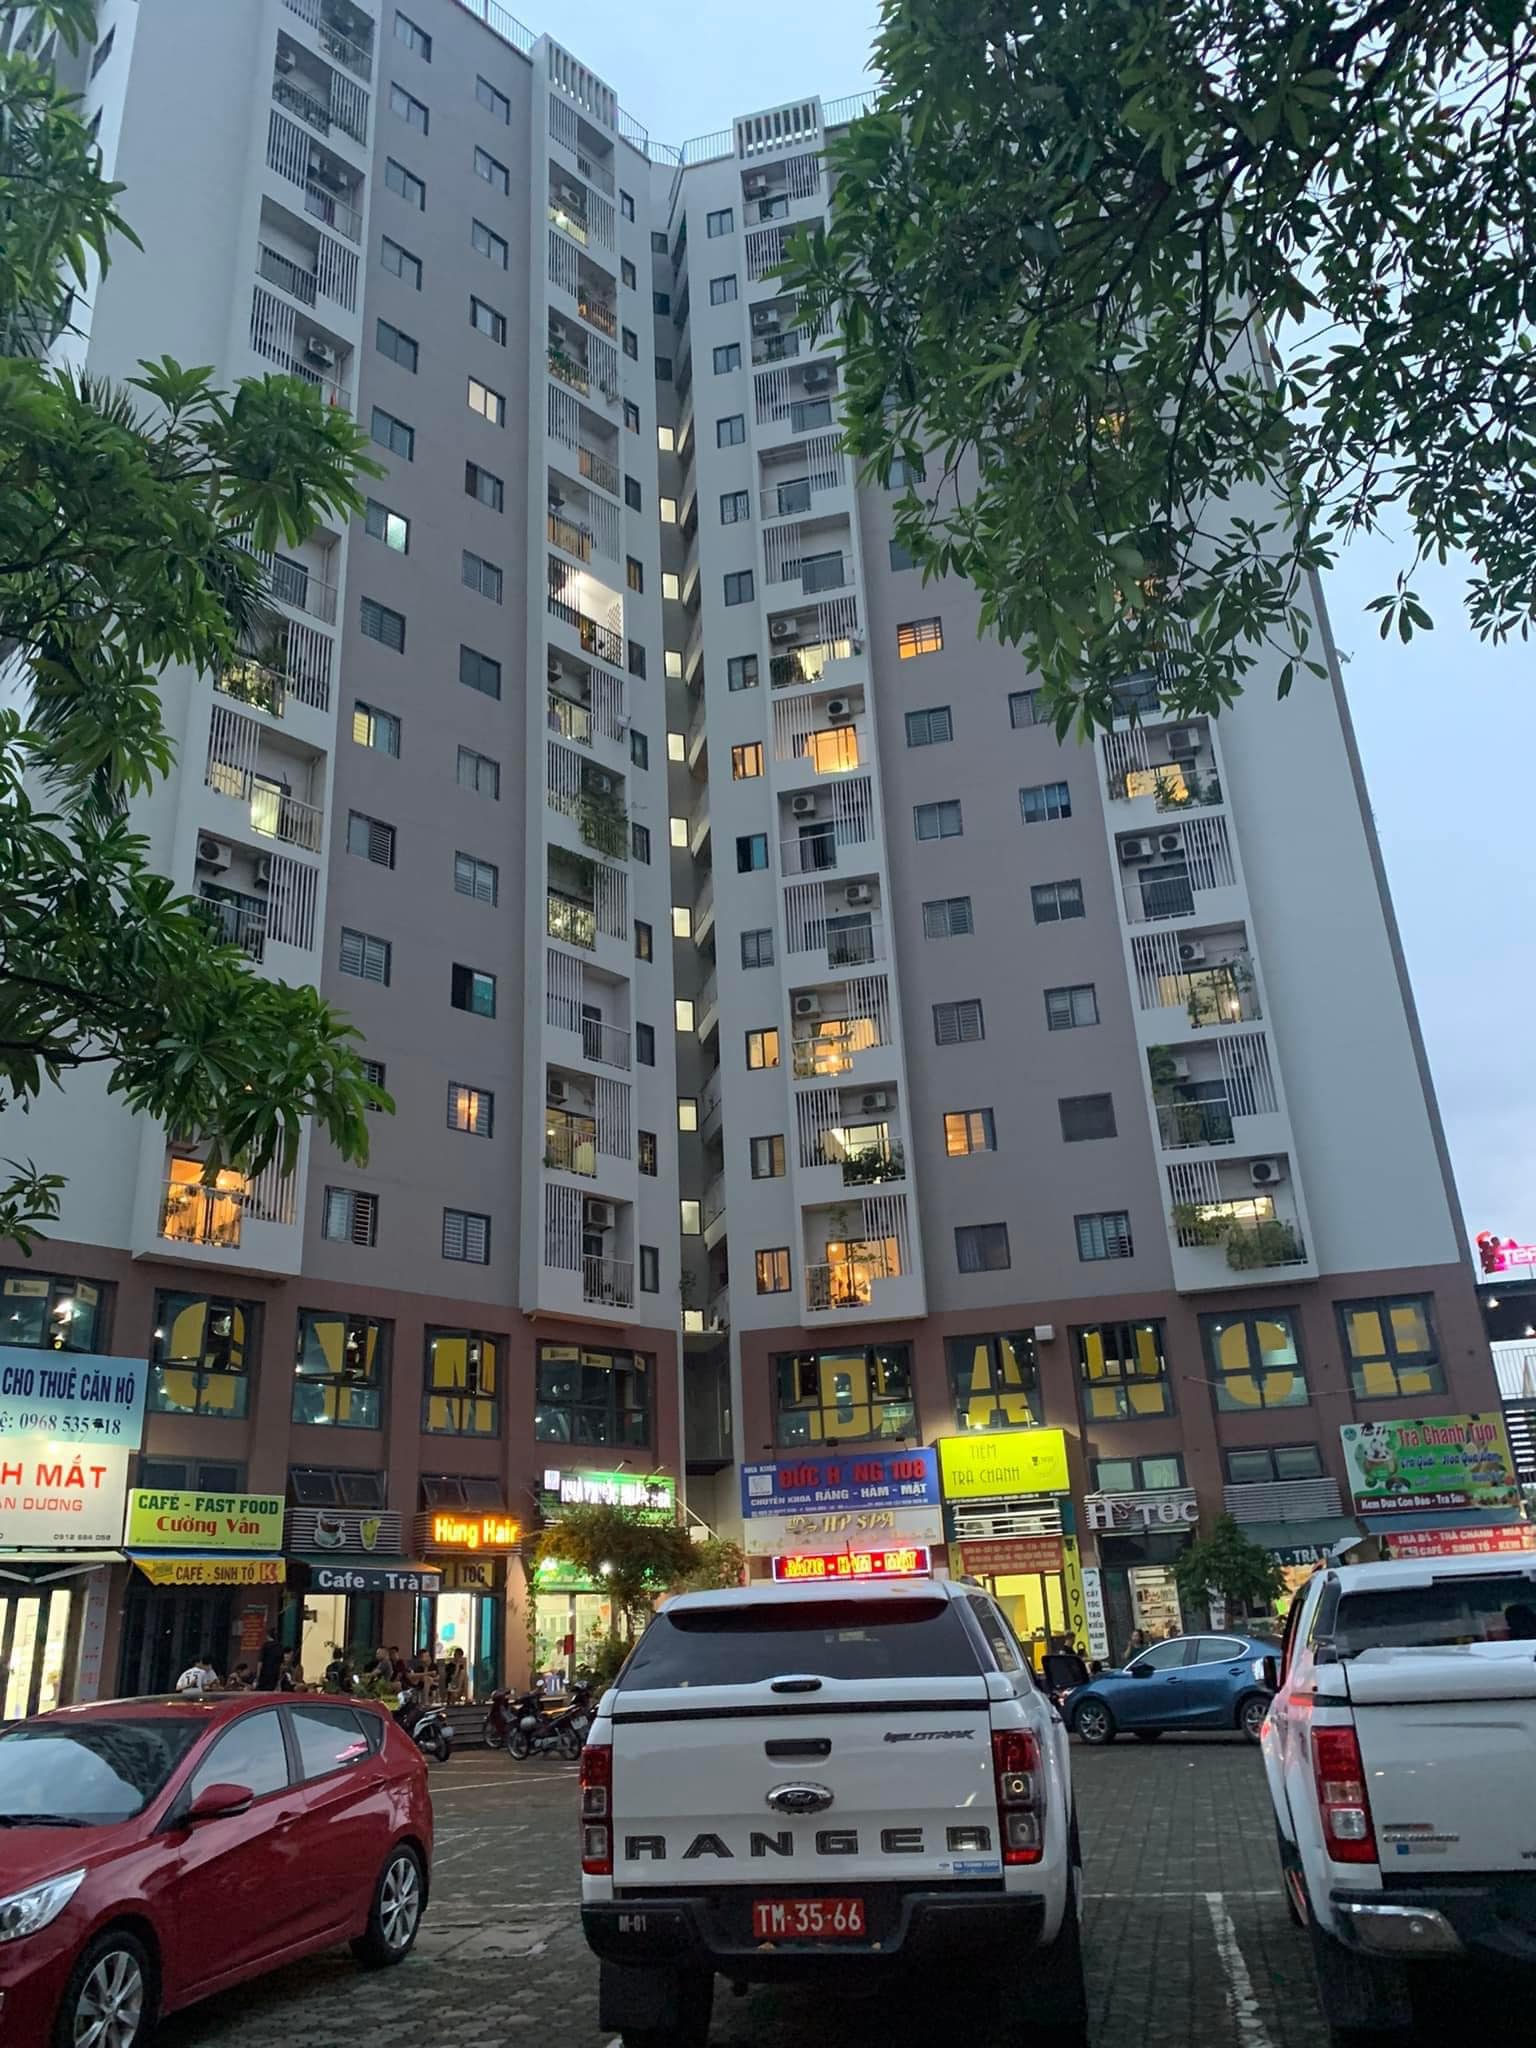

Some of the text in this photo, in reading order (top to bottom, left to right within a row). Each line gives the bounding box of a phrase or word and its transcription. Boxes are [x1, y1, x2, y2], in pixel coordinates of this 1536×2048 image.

[2, 1366, 135, 1410] CHO THUÊ CĂN HỘ
[19, 1412, 58, 1431] 0968
[62, 1416, 89, 1433] 535
[1424, 1425, 1465, 1445] Chanh
[36, 1454, 107, 1489] MẮT
[980, 1466, 1020, 1483] CHANH
[815, 1487, 849, 1502] RĂNG
[861, 1484, 889, 1499] HÀM
[901, 1482, 927, 1497] MẶT
[23, 1497, 83, 1513] DƯƠNG
[195, 1498, 236, 1513] FAST
[239, 1500, 279, 1515] FOOD
[156, 1515, 260, 1536] Cường Vân
[435, 1516, 518, 1548] Hùng Hair
[1292, 1545, 1319, 1563] TRÀ
[214, 1567, 238, 1580] SINH
[319, 1570, 419, 1591] Cafe Trà
[625, 1825, 993, 1861] RANGER
